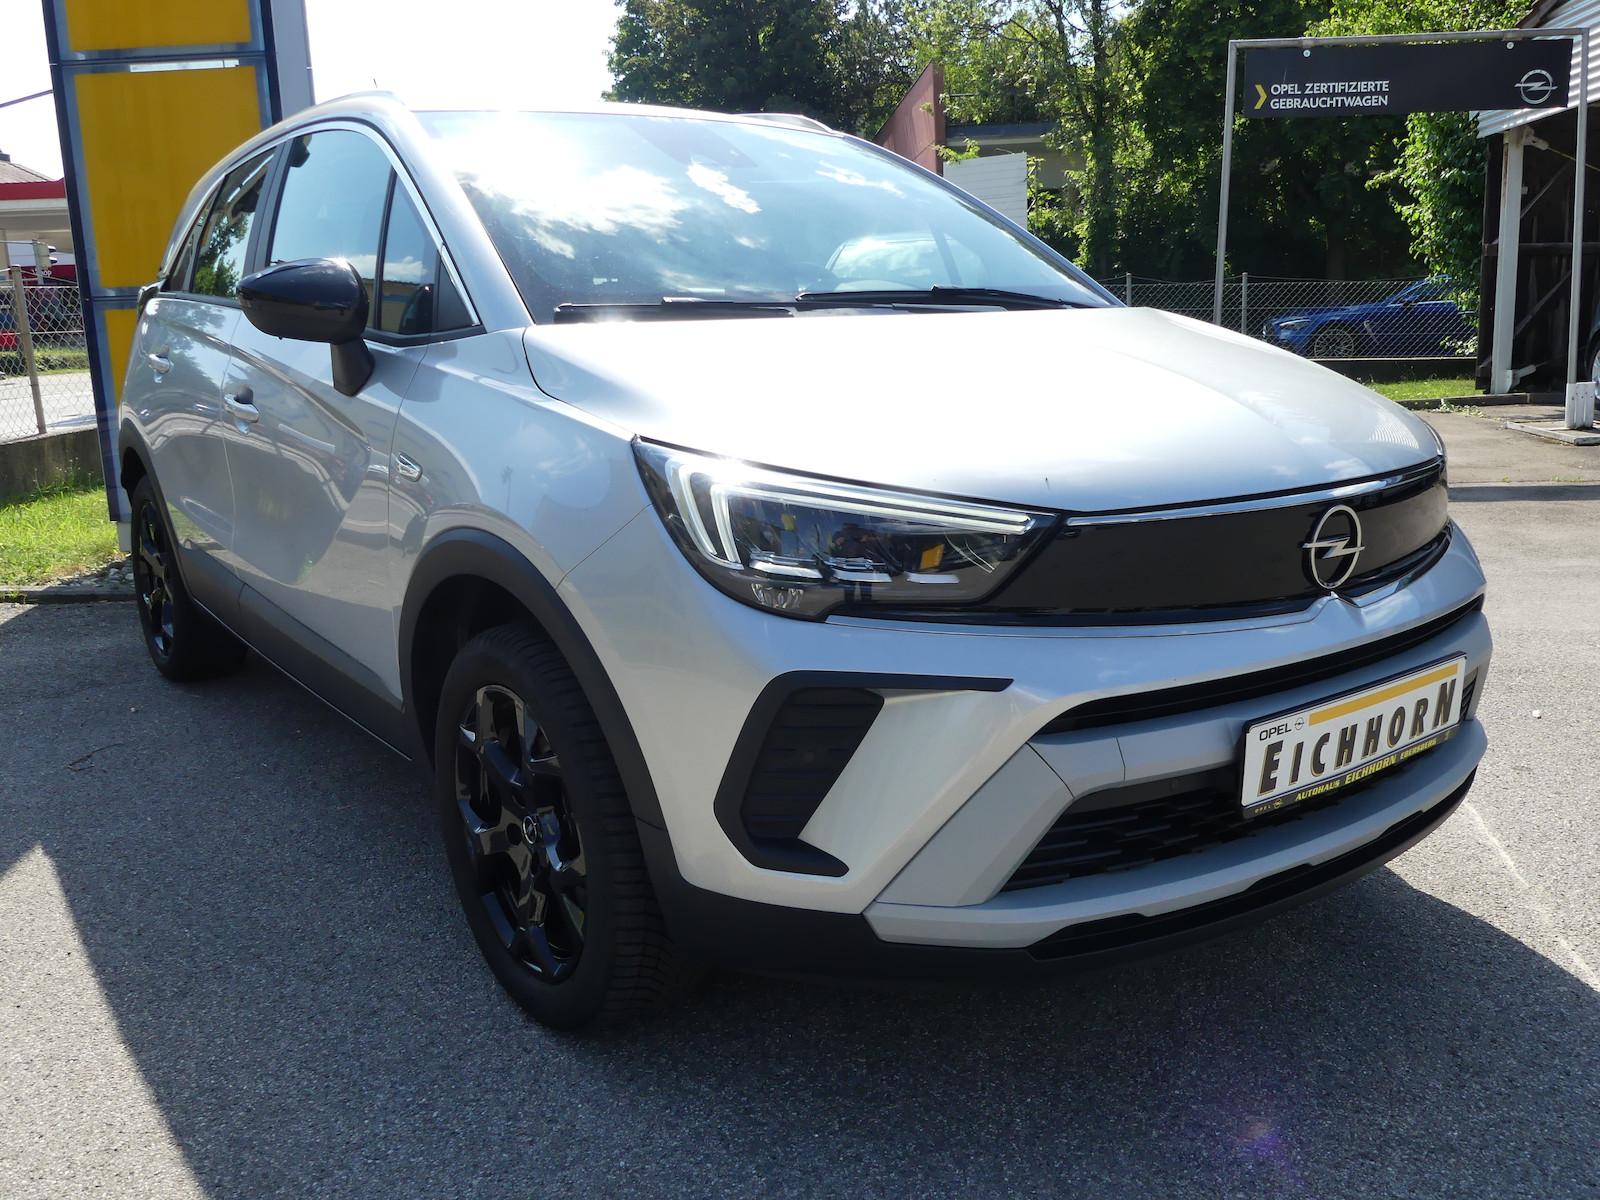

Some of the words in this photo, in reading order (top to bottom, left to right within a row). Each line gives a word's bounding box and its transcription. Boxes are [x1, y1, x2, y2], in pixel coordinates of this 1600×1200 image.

[1270, 84, 1301, 95] OPEL
[1304, 81, 1390, 94] ZERTIFIZIERTE
[1270, 95, 1388, 109] GEBRAUCHTWAGEN
[1257, 678, 1457, 797] EICHHORN
[1259, 723, 1292, 741] OPEL
[1295, 780, 1340, 801] AUTOHAUS
[1345, 754, 1397, 784] EICHHORN
